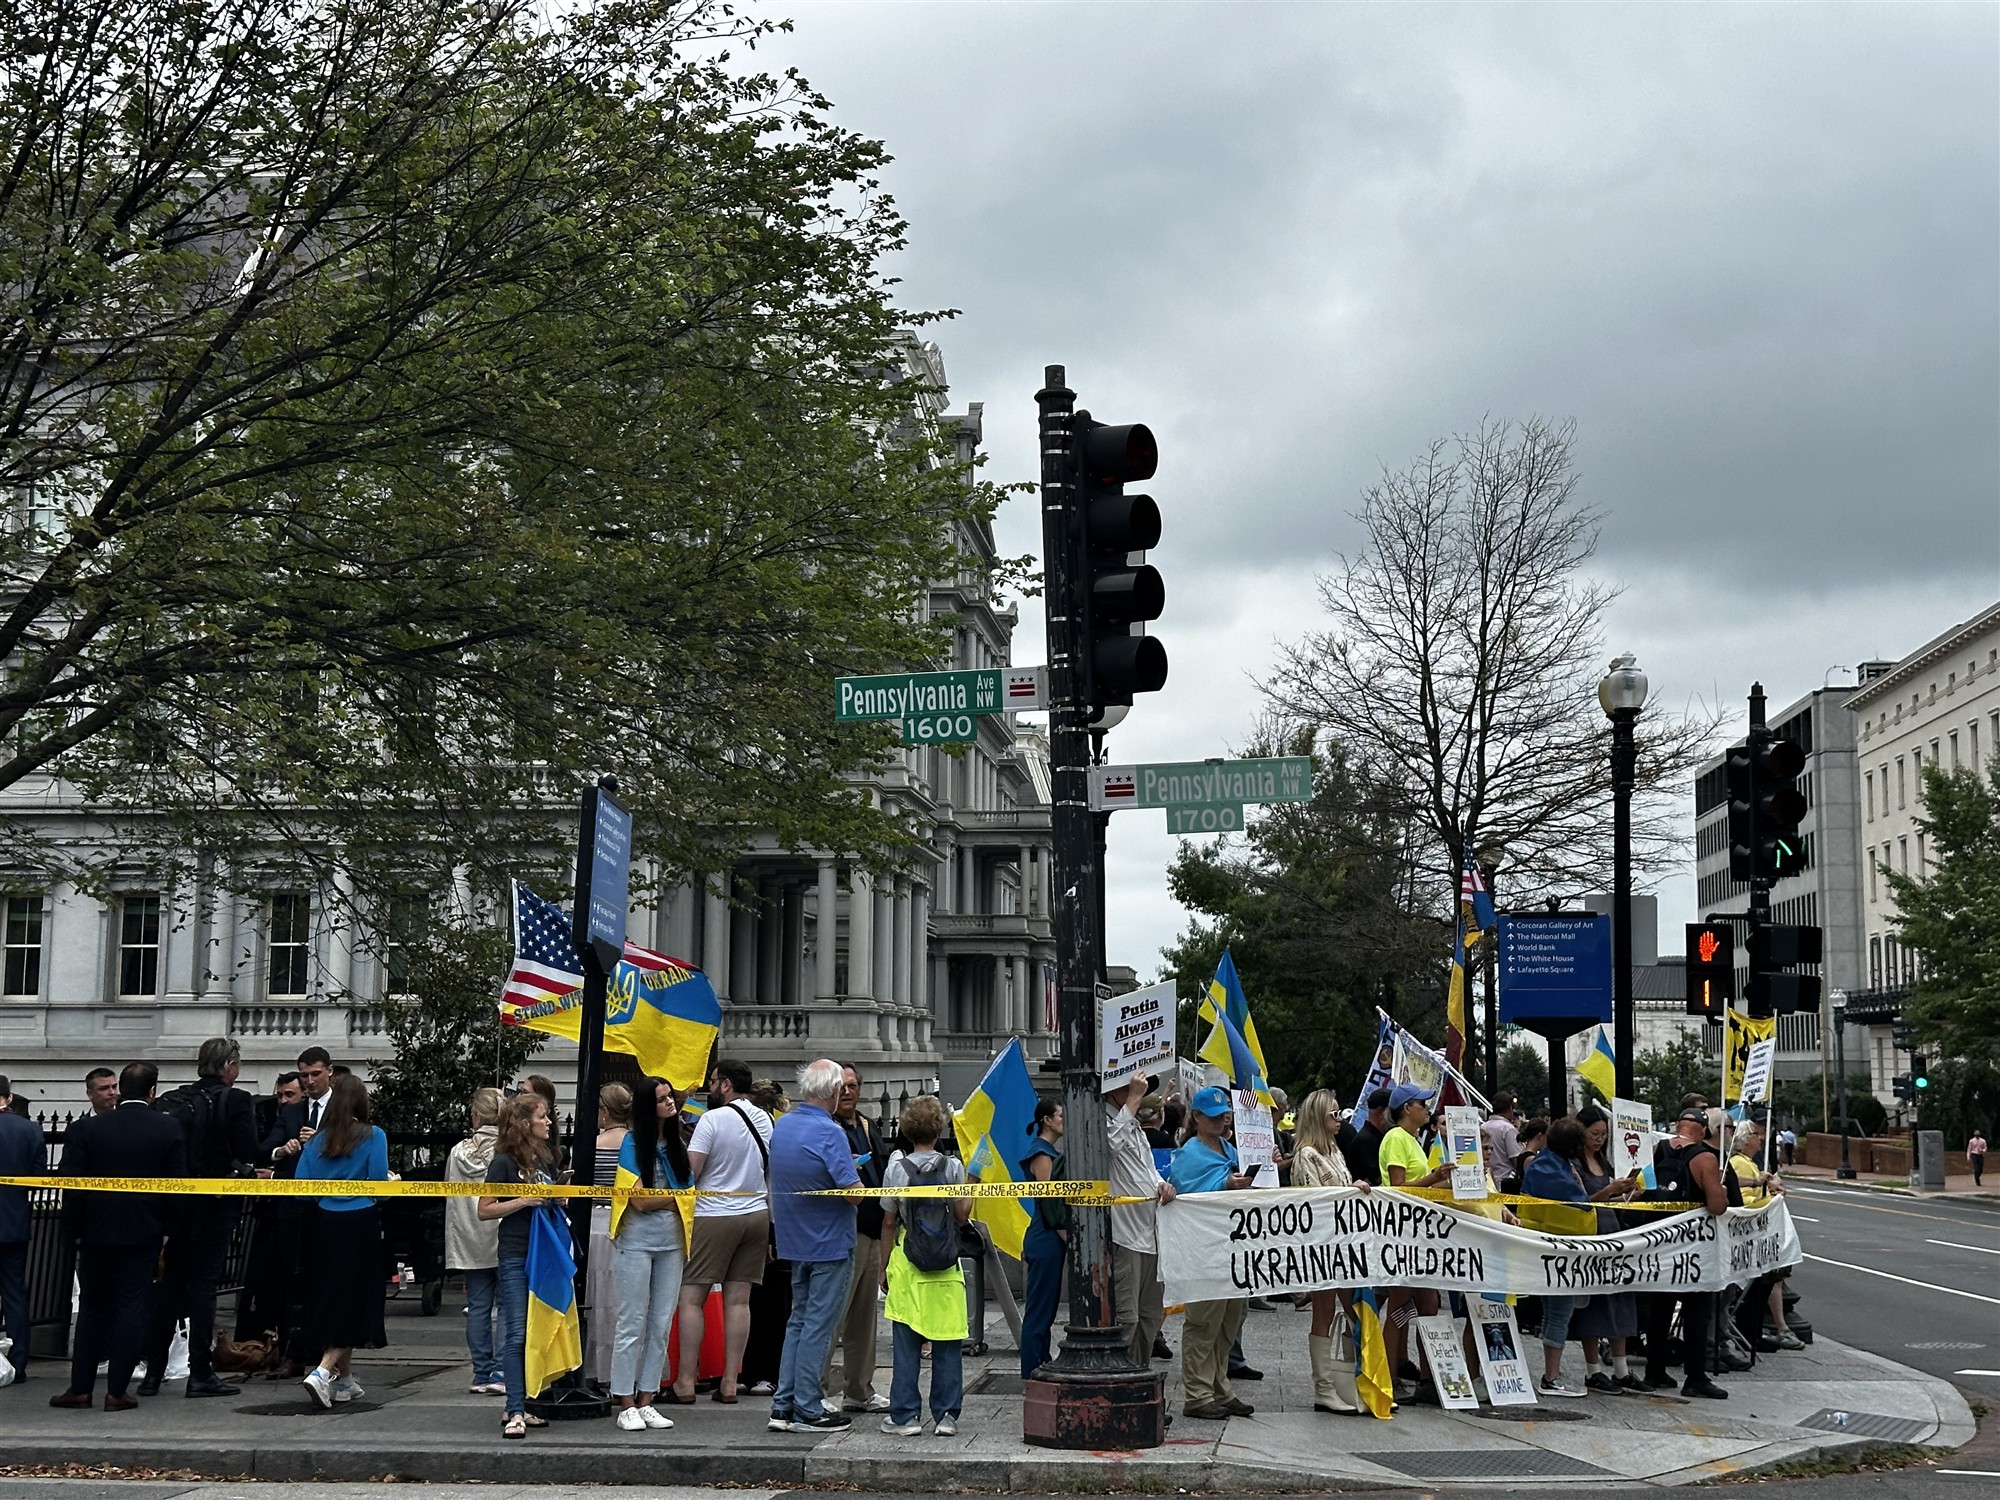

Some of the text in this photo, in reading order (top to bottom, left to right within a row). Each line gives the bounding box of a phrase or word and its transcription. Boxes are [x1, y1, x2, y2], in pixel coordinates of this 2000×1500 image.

[841, 674, 994, 718] Pennsylvania Ave
[976, 691, 994, 708] NW
[907, 715, 972, 739] 1600
[1144, 762, 1302, 802] Pennsylvania Ave
[1282, 779, 1300, 795] NW
[1174, 808, 1236, 831] 1700
[1548, 922, 1572, 930] Gallery
[642, 966, 696, 992] UKRAIN
[1517, 966, 1574, 974] Lafayette Square
[514, 988, 584, 1022] STAND WIT
[1120, 998, 1159, 1020] Putin
[1114, 1016, 1164, 1040] Always
[1122, 1033, 1156, 1056] Lies!
[1103, 1048, 1174, 1080] Support Ukraine!
[1229, 1199, 1458, 1243] 20,000 KIDNAPPED
[1230, 1242, 1484, 1291] UKRAINIAN CHILDREN
[1541, 1252, 1701, 1288] TRAINEES IN HIS
[1474, 1304, 1511, 1320] WE STAND
[1494, 1364, 1518, 1378] WITH
[1493, 1378, 1526, 1394] UKRAINE
